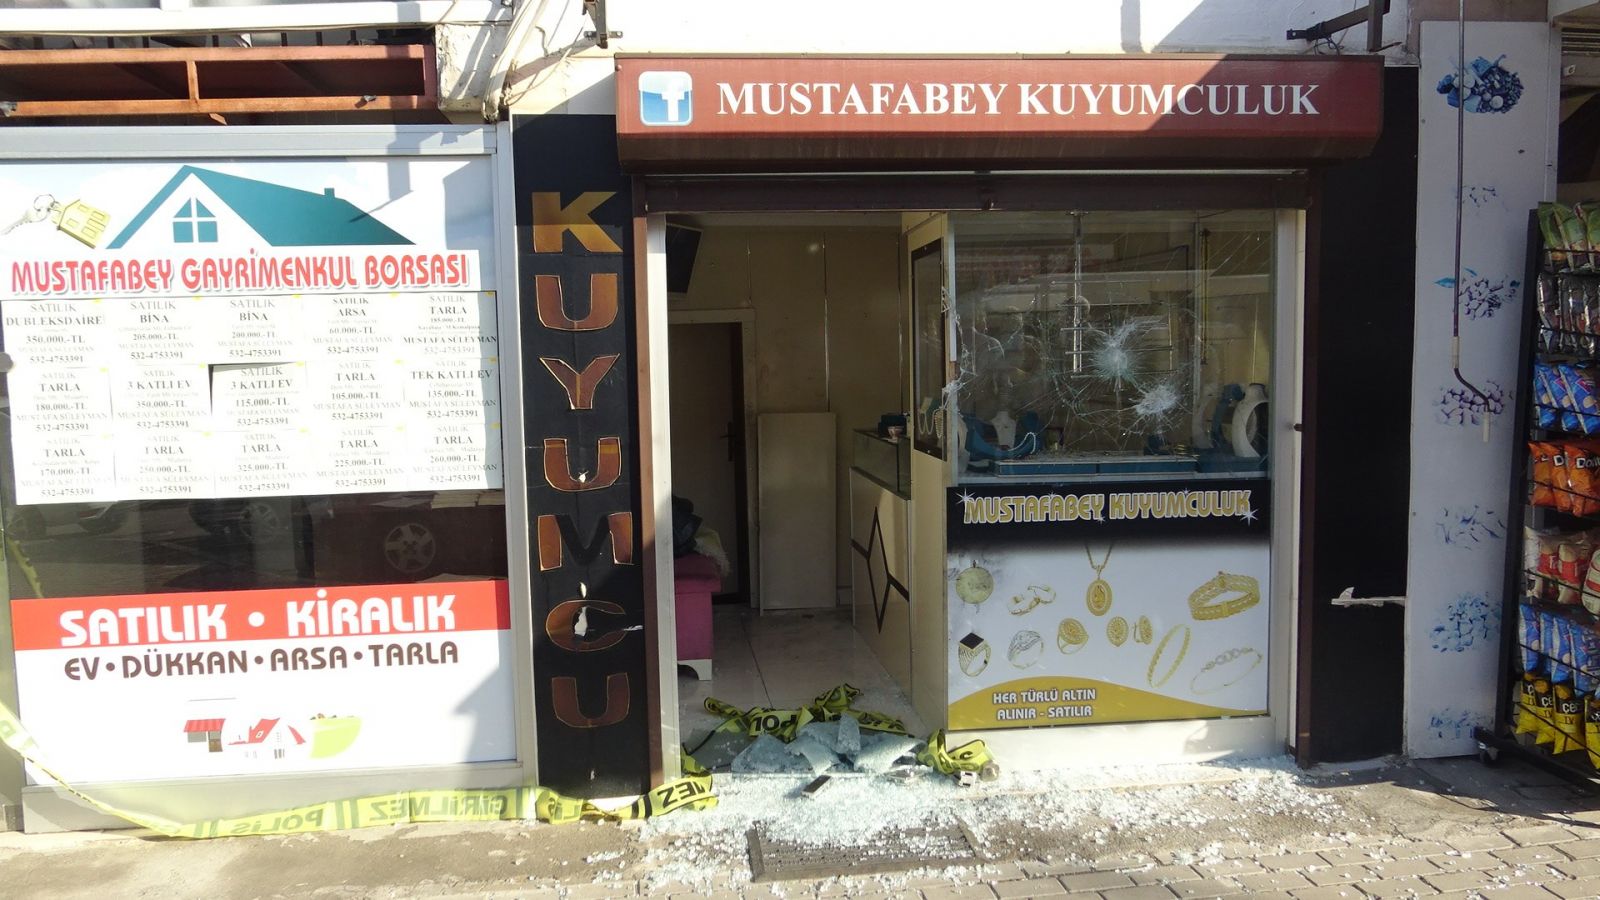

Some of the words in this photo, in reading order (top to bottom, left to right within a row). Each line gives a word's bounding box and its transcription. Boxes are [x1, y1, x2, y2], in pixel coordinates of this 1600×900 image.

[716, 82, 1010, 117] MUSTAFABEY
[1018, 81, 1320, 117] KUYUMCULUK
[11, 258, 175, 295] MUSTAFABEY
[181, 247, 359, 292] GAYRİMENKUL
[364, 254, 469, 288] BORSASI
[30, 304, 77, 312] SATILIK
[130, 301, 176, 310] SATILIK
[230, 300, 276, 308] SATILIK
[338, 308, 366, 317] ARSA
[431, 306, 468, 314] TARLA
[140, 312, 170, 323] BİNA
[239, 312, 269, 322] BİNA
[240, 367, 283, 377] SATILIK
[336, 372, 376, 382] TARLA
[410, 370, 436, 380] TEK
[478, 370, 493, 379] EV
[40, 382, 81, 392] TARLA
[230, 381, 236, 390] 3
[278, 379, 293, 388] EV
[332, 412, 383, 420] 532-4753391
[427, 410, 478, 418] 532-4753391
[338, 440, 379, 448] TARLA
[434, 436, 474, 445] TARLA
[44, 448, 87, 458] TARLA
[144, 446, 185, 454] TARLA
[241, 444, 282, 454] TARLA
[335, 479, 386, 488] 532-4753391
[964, 494, 1105, 524] MUSTAFABEY
[1109, 489, 1252, 520] KUYUMCULUK
[60, 604, 227, 647] SATILIK
[286, 589, 457, 637] KİRALIK
[64, 657, 100, 681] EV
[122, 648, 248, 678] DÜKKAN
[270, 645, 348, 671] ARSA
[368, 641, 460, 667] TARLA
[992, 692, 1018, 704] HER
[1020, 689, 1058, 703] TÜRLÜ
[1062, 688, 1096, 701] ALTIN
[996, 708, 1036, 720] ALINIR
[1047, 706, 1093, 718] SATILIR
